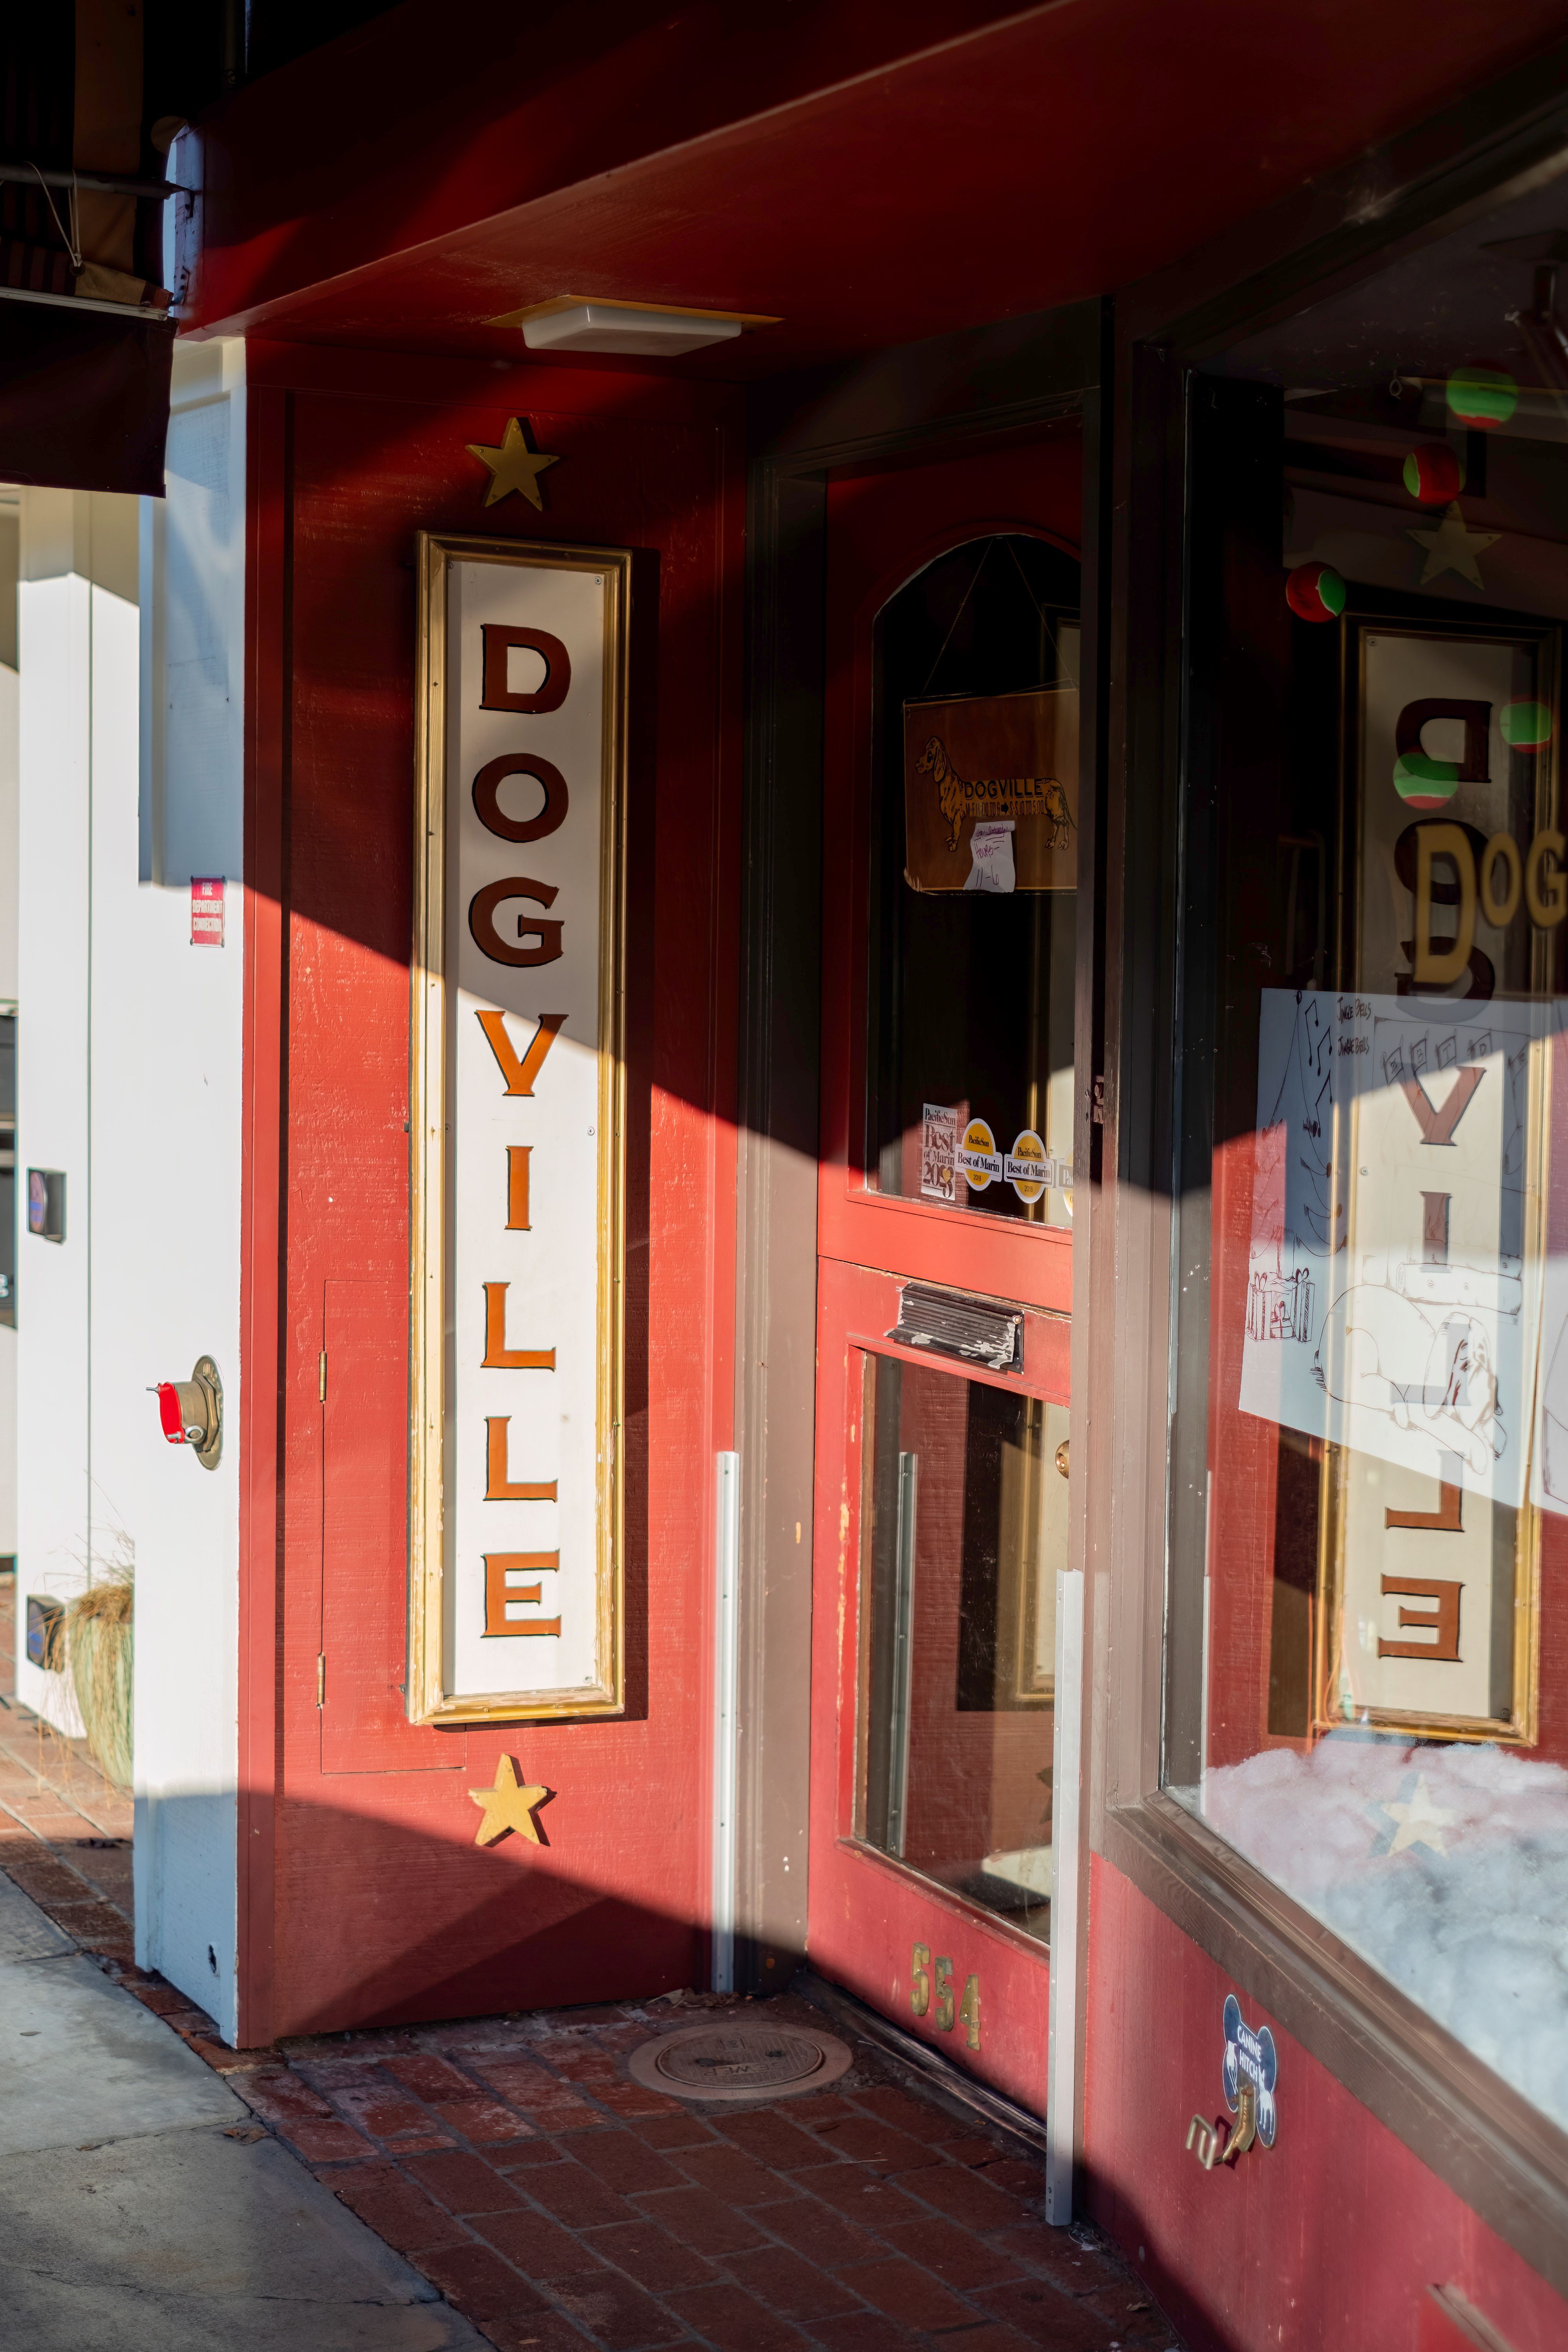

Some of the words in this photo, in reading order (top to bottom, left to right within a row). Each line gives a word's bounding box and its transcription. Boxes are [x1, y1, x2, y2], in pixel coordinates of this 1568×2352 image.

[964, 778, 1044, 800] DOGVILLE
[976, 864, 999, 887] 11-6
[468, 623, 571, 1639] DOGVILLE
[924, 1124, 955, 1153] Best
[924, 1148, 932, 1160] of
[932, 1151, 955, 1166] Marin
[958, 1152, 972, 1165] Best
[973, 1156, 980, 1167] of
[980, 1157, 1000, 1172] Marin
[1007, 1161, 1022, 1174] Best
[1023, 1163, 1031, 1175] of
[1031, 1164, 1051, 1178] Marin
[910, 1942, 981, 2051] 554
[1237, 2025, 1261, 2062] CANINE
[1239, 2049, 1258, 2083] HITCH
